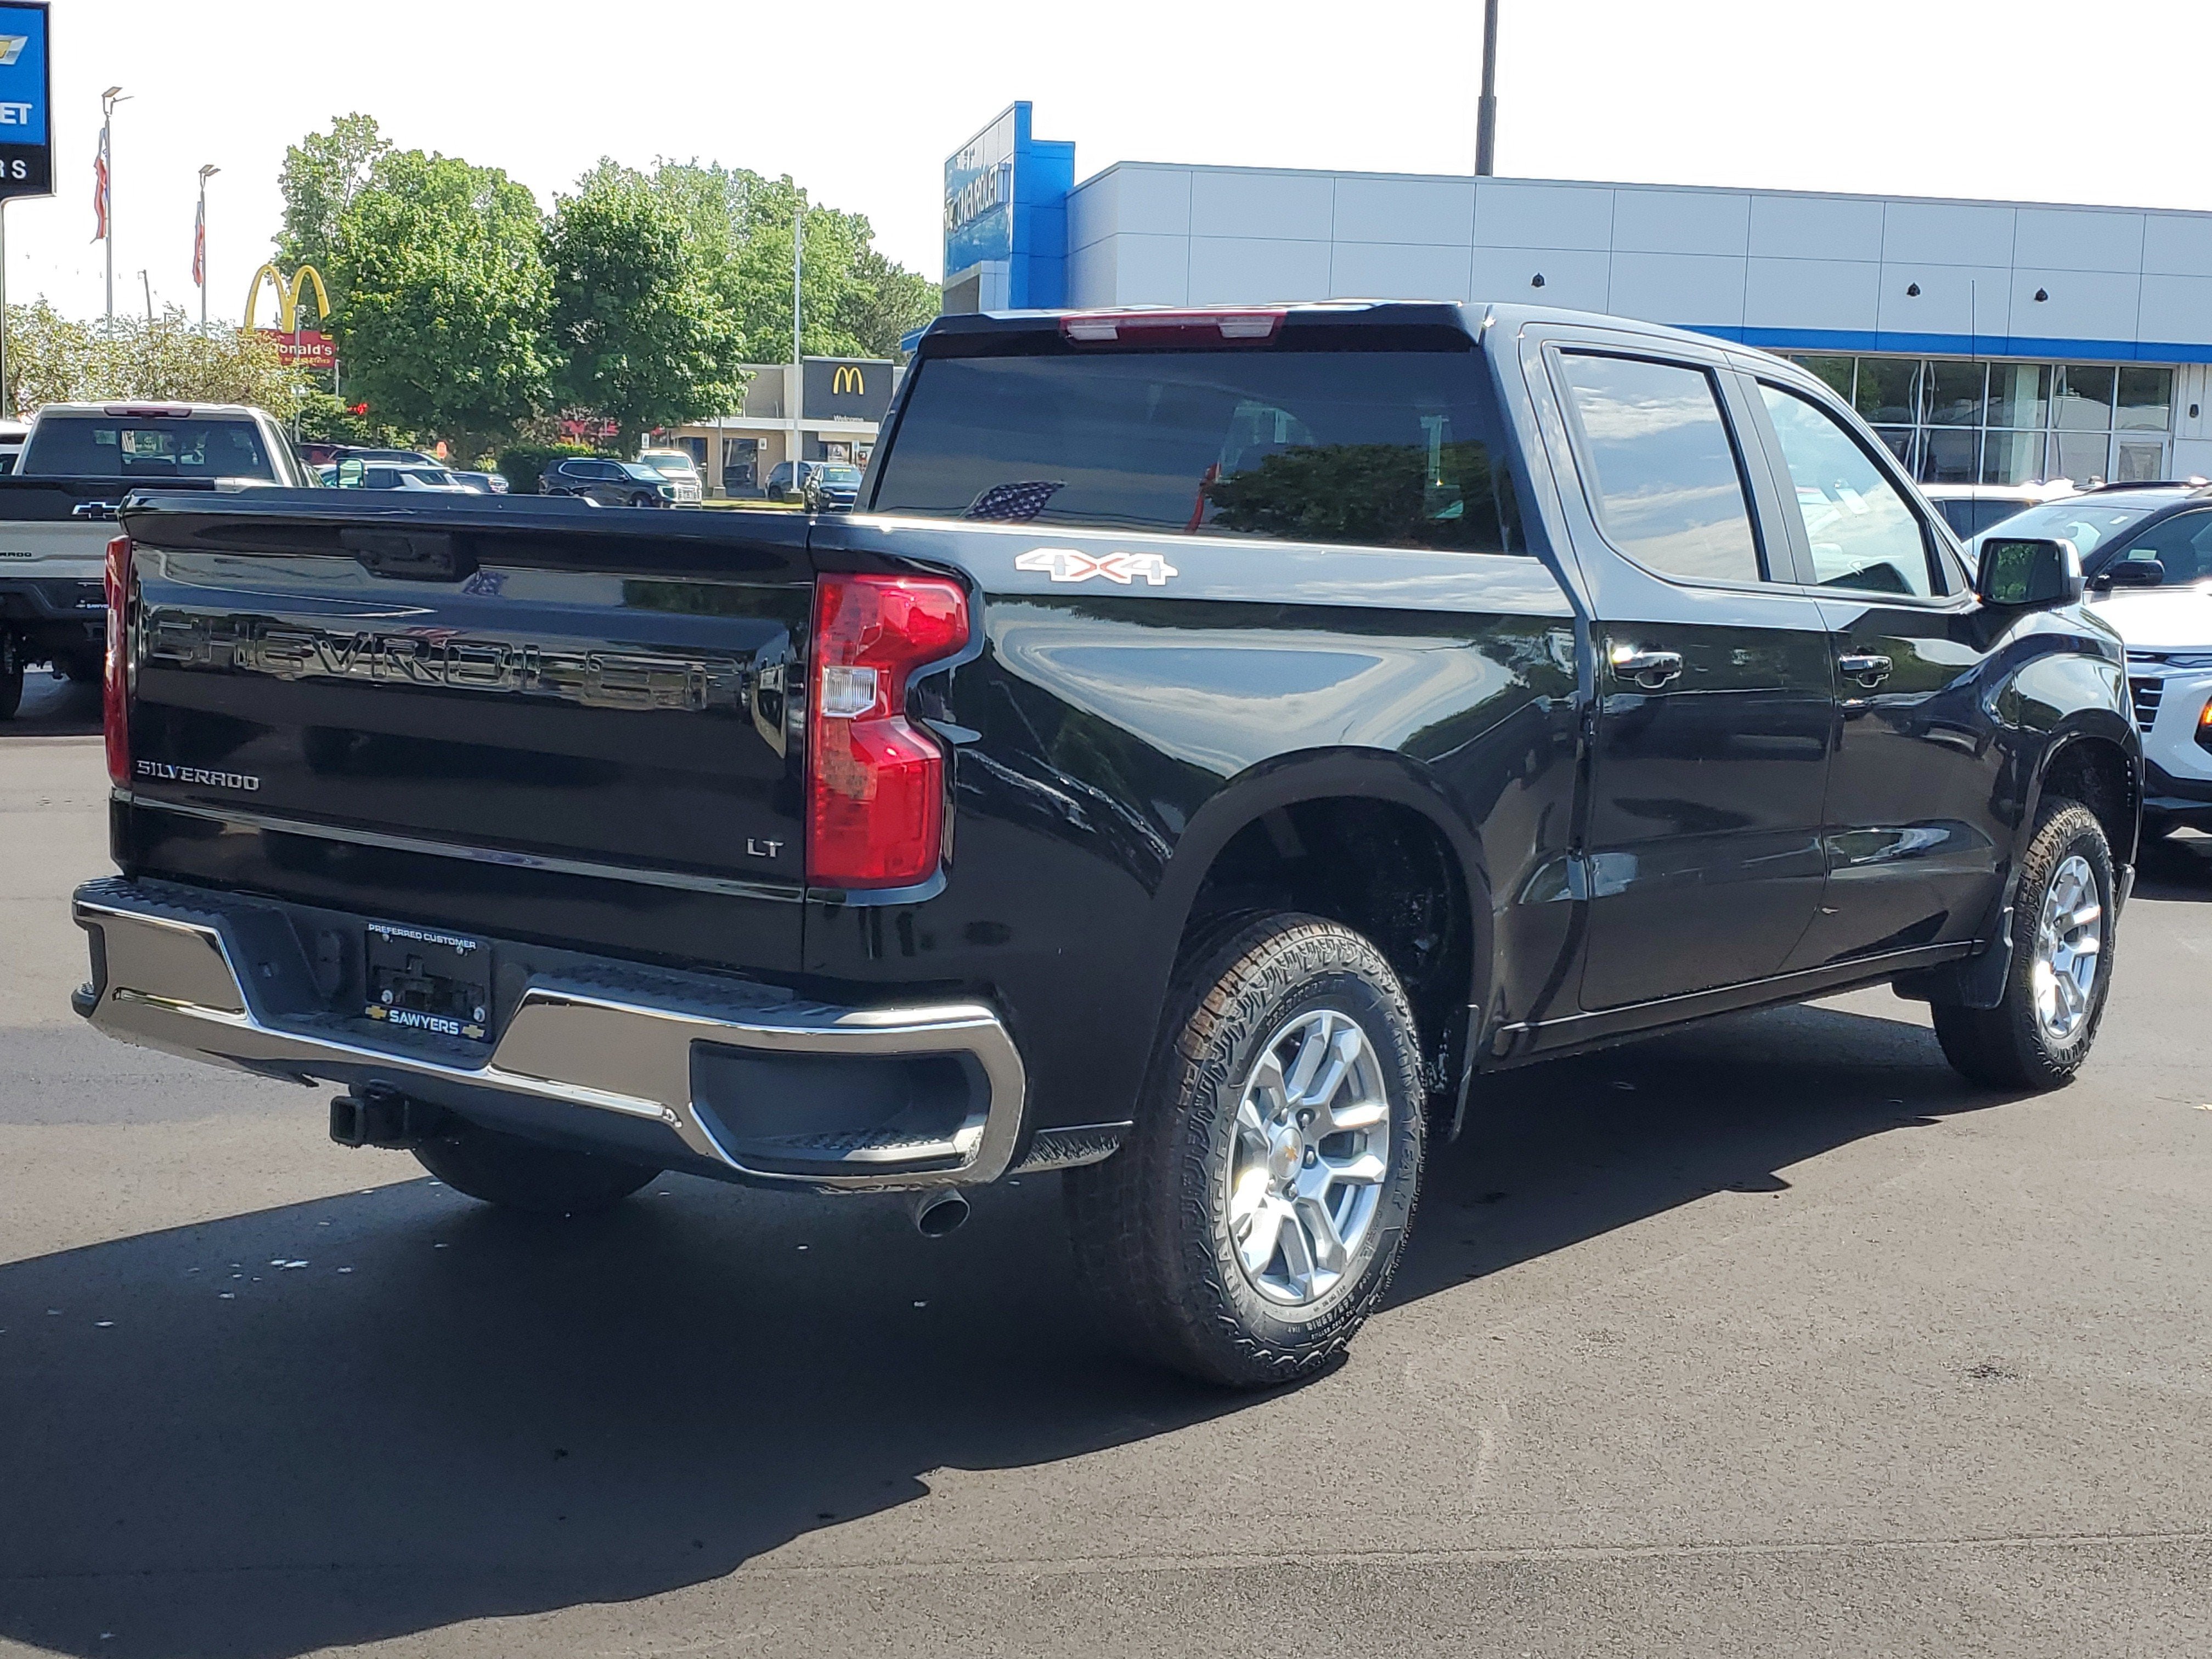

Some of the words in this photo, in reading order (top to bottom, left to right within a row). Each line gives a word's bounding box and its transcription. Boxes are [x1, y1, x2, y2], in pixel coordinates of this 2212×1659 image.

[150, 612, 740, 712] CHEVROLET
[137, 760, 261, 791] SILVERADO
[747, 838, 785, 857] LT
[368, 923, 422, 939] PREFERRED
[424, 933, 476, 950] CUSTOMER
[389, 1009, 459, 1035] SAWYERS
